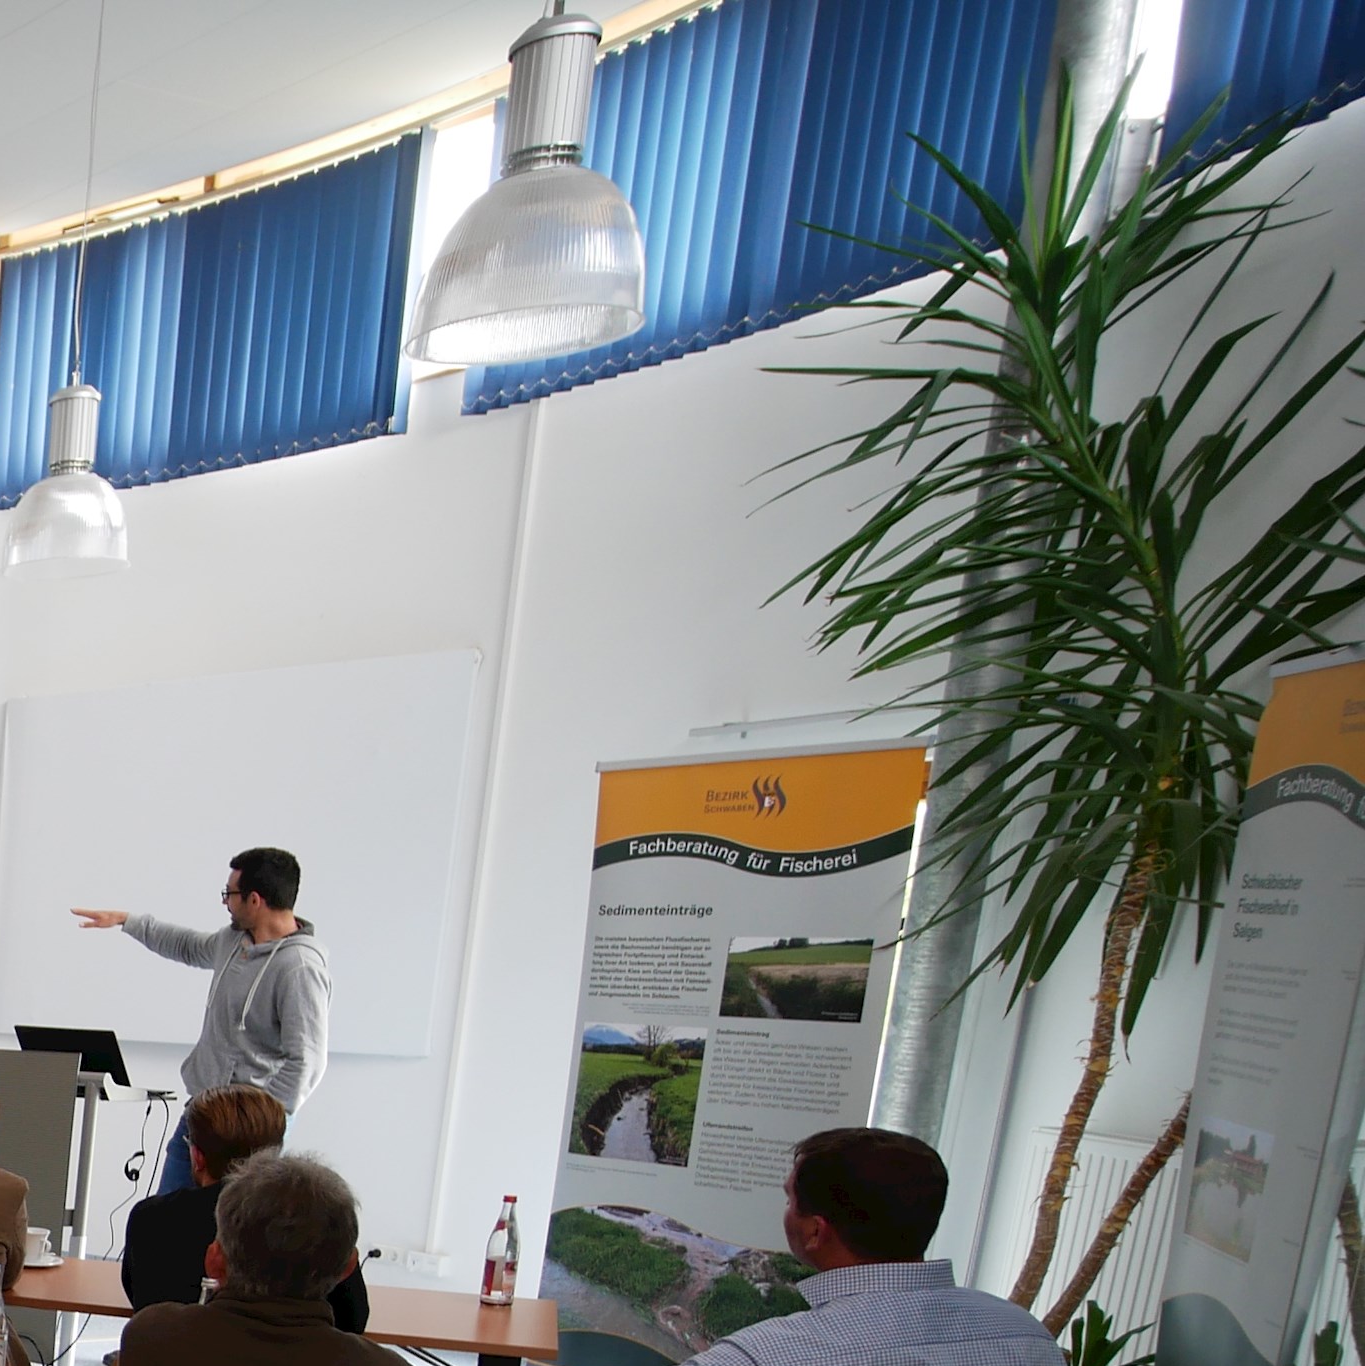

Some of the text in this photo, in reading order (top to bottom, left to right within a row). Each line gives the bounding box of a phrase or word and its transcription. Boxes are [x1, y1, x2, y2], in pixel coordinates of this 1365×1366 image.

[705, 790, 749, 801] BEZIRK
[1276, 772, 1355, 813] Fachberatung
[628, 837, 858, 873] Fachberatung für Fischerei
[1241, 873, 1304, 891] Schwäbischer
[598, 904, 713, 919] Sedimenteinträge
[1237, 898, 1291, 916] Fischereihof
